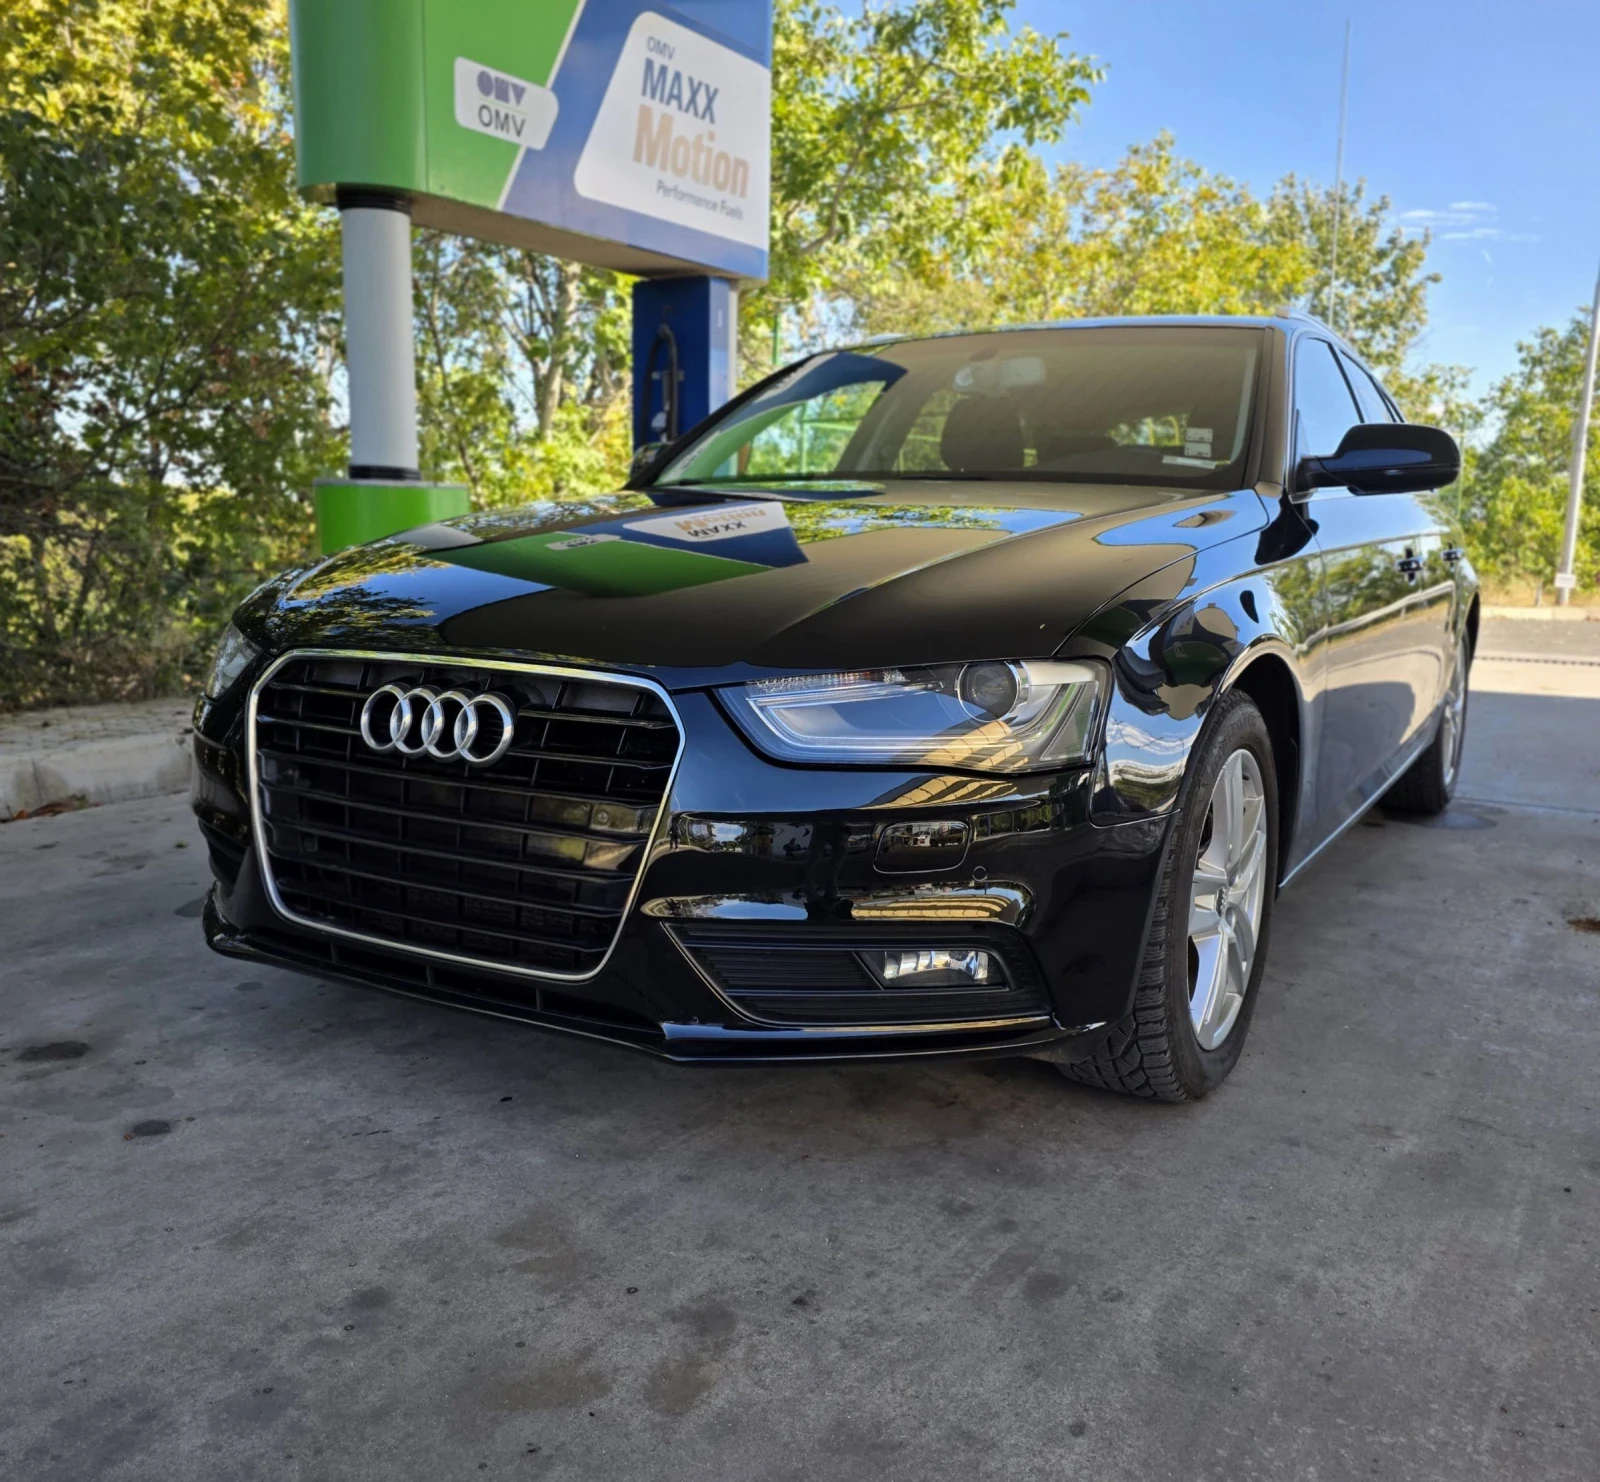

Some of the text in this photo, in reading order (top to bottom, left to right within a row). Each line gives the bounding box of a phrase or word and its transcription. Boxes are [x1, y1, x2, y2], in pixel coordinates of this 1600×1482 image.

[647, 36, 676, 60] OMV
[641, 57, 719, 125] MAXX
[478, 104, 526, 137] OMV
[633, 103, 749, 198] Motion
[656, 179, 744, 220] Performance Fuels
